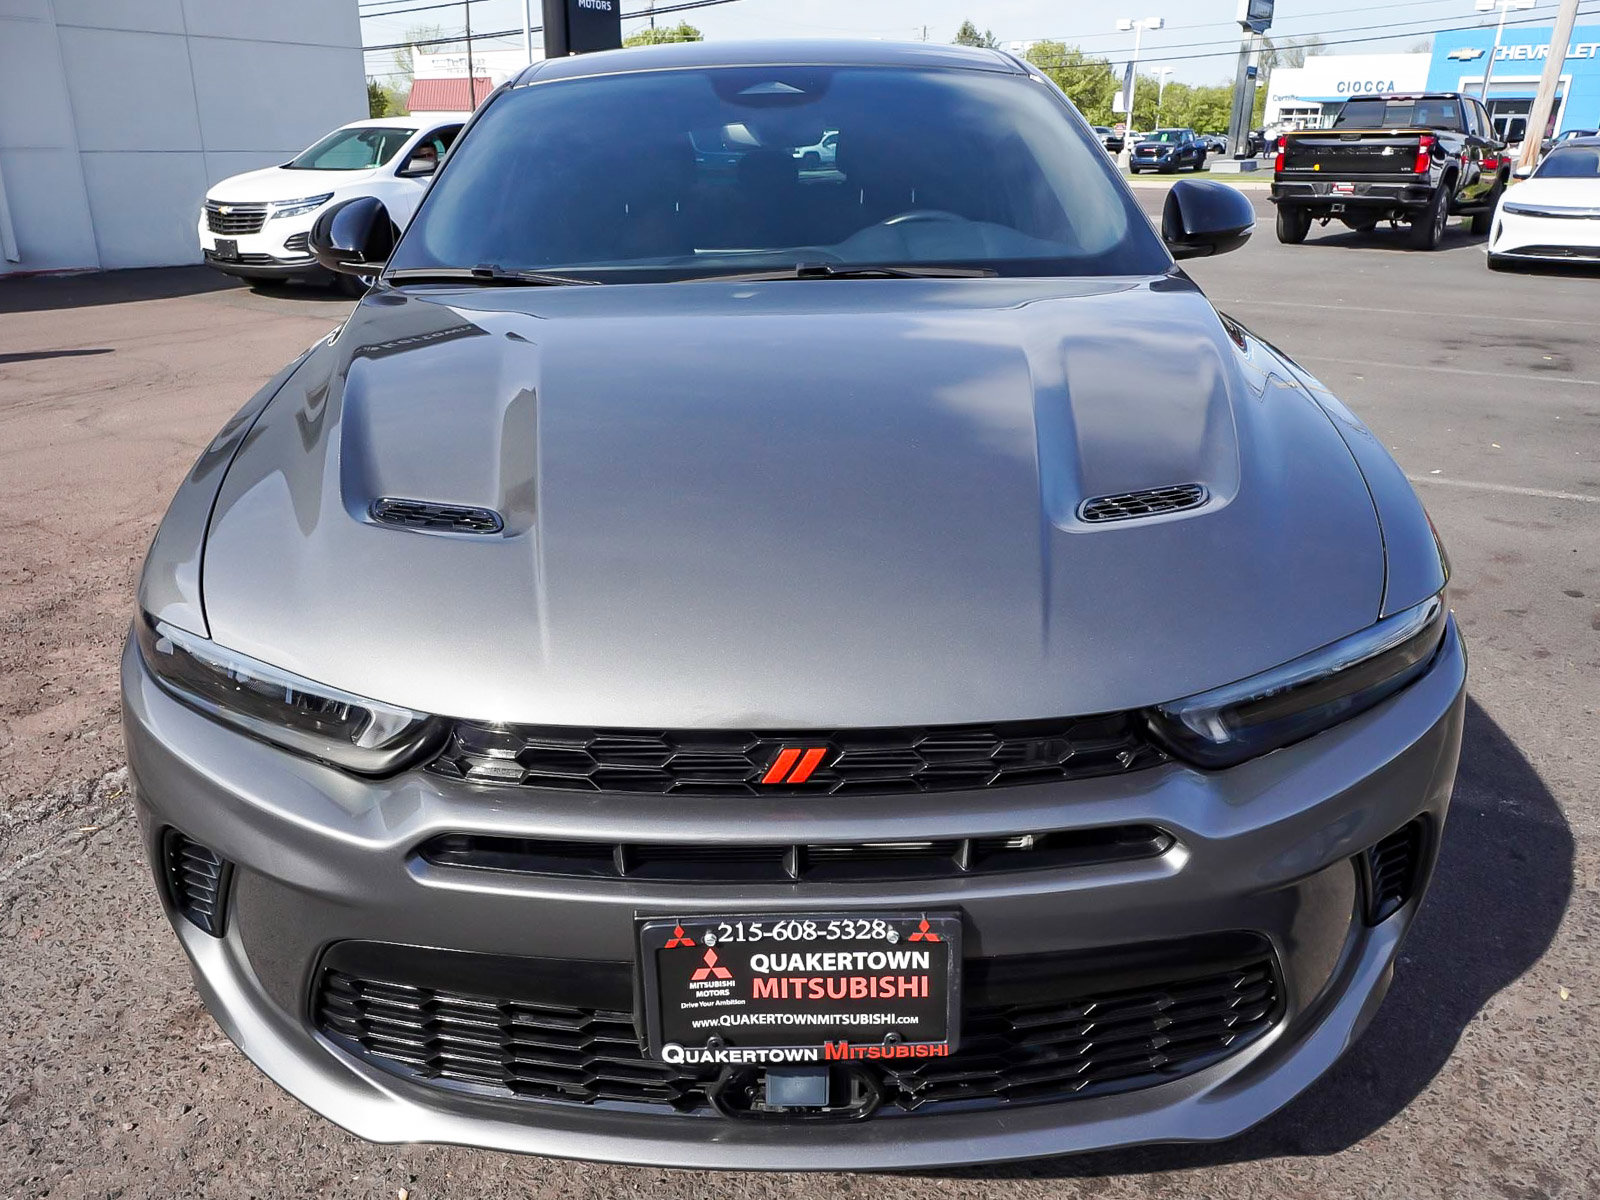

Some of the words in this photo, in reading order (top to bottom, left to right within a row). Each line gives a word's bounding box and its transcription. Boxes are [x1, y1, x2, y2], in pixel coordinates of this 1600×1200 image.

[578, 0, 612, 11] MOTORS
[1494, 42, 1600, 61] CHEVRLET
[1337, 80, 1395, 93] CIOCCA
[717, 920, 886, 943] 215-608-5328
[750, 951, 930, 973] QUAKERTOWN
[689, 980, 736, 989] MITSUBISHI
[752, 975, 929, 999] MITSUBISHI
[695, 989, 730, 998] MOTORS
[715, 999, 746, 1007] Ambition
[661, 1045, 818, 1064] QUAKERTOWN
[824, 1041, 949, 1061] MITSUBISHI
